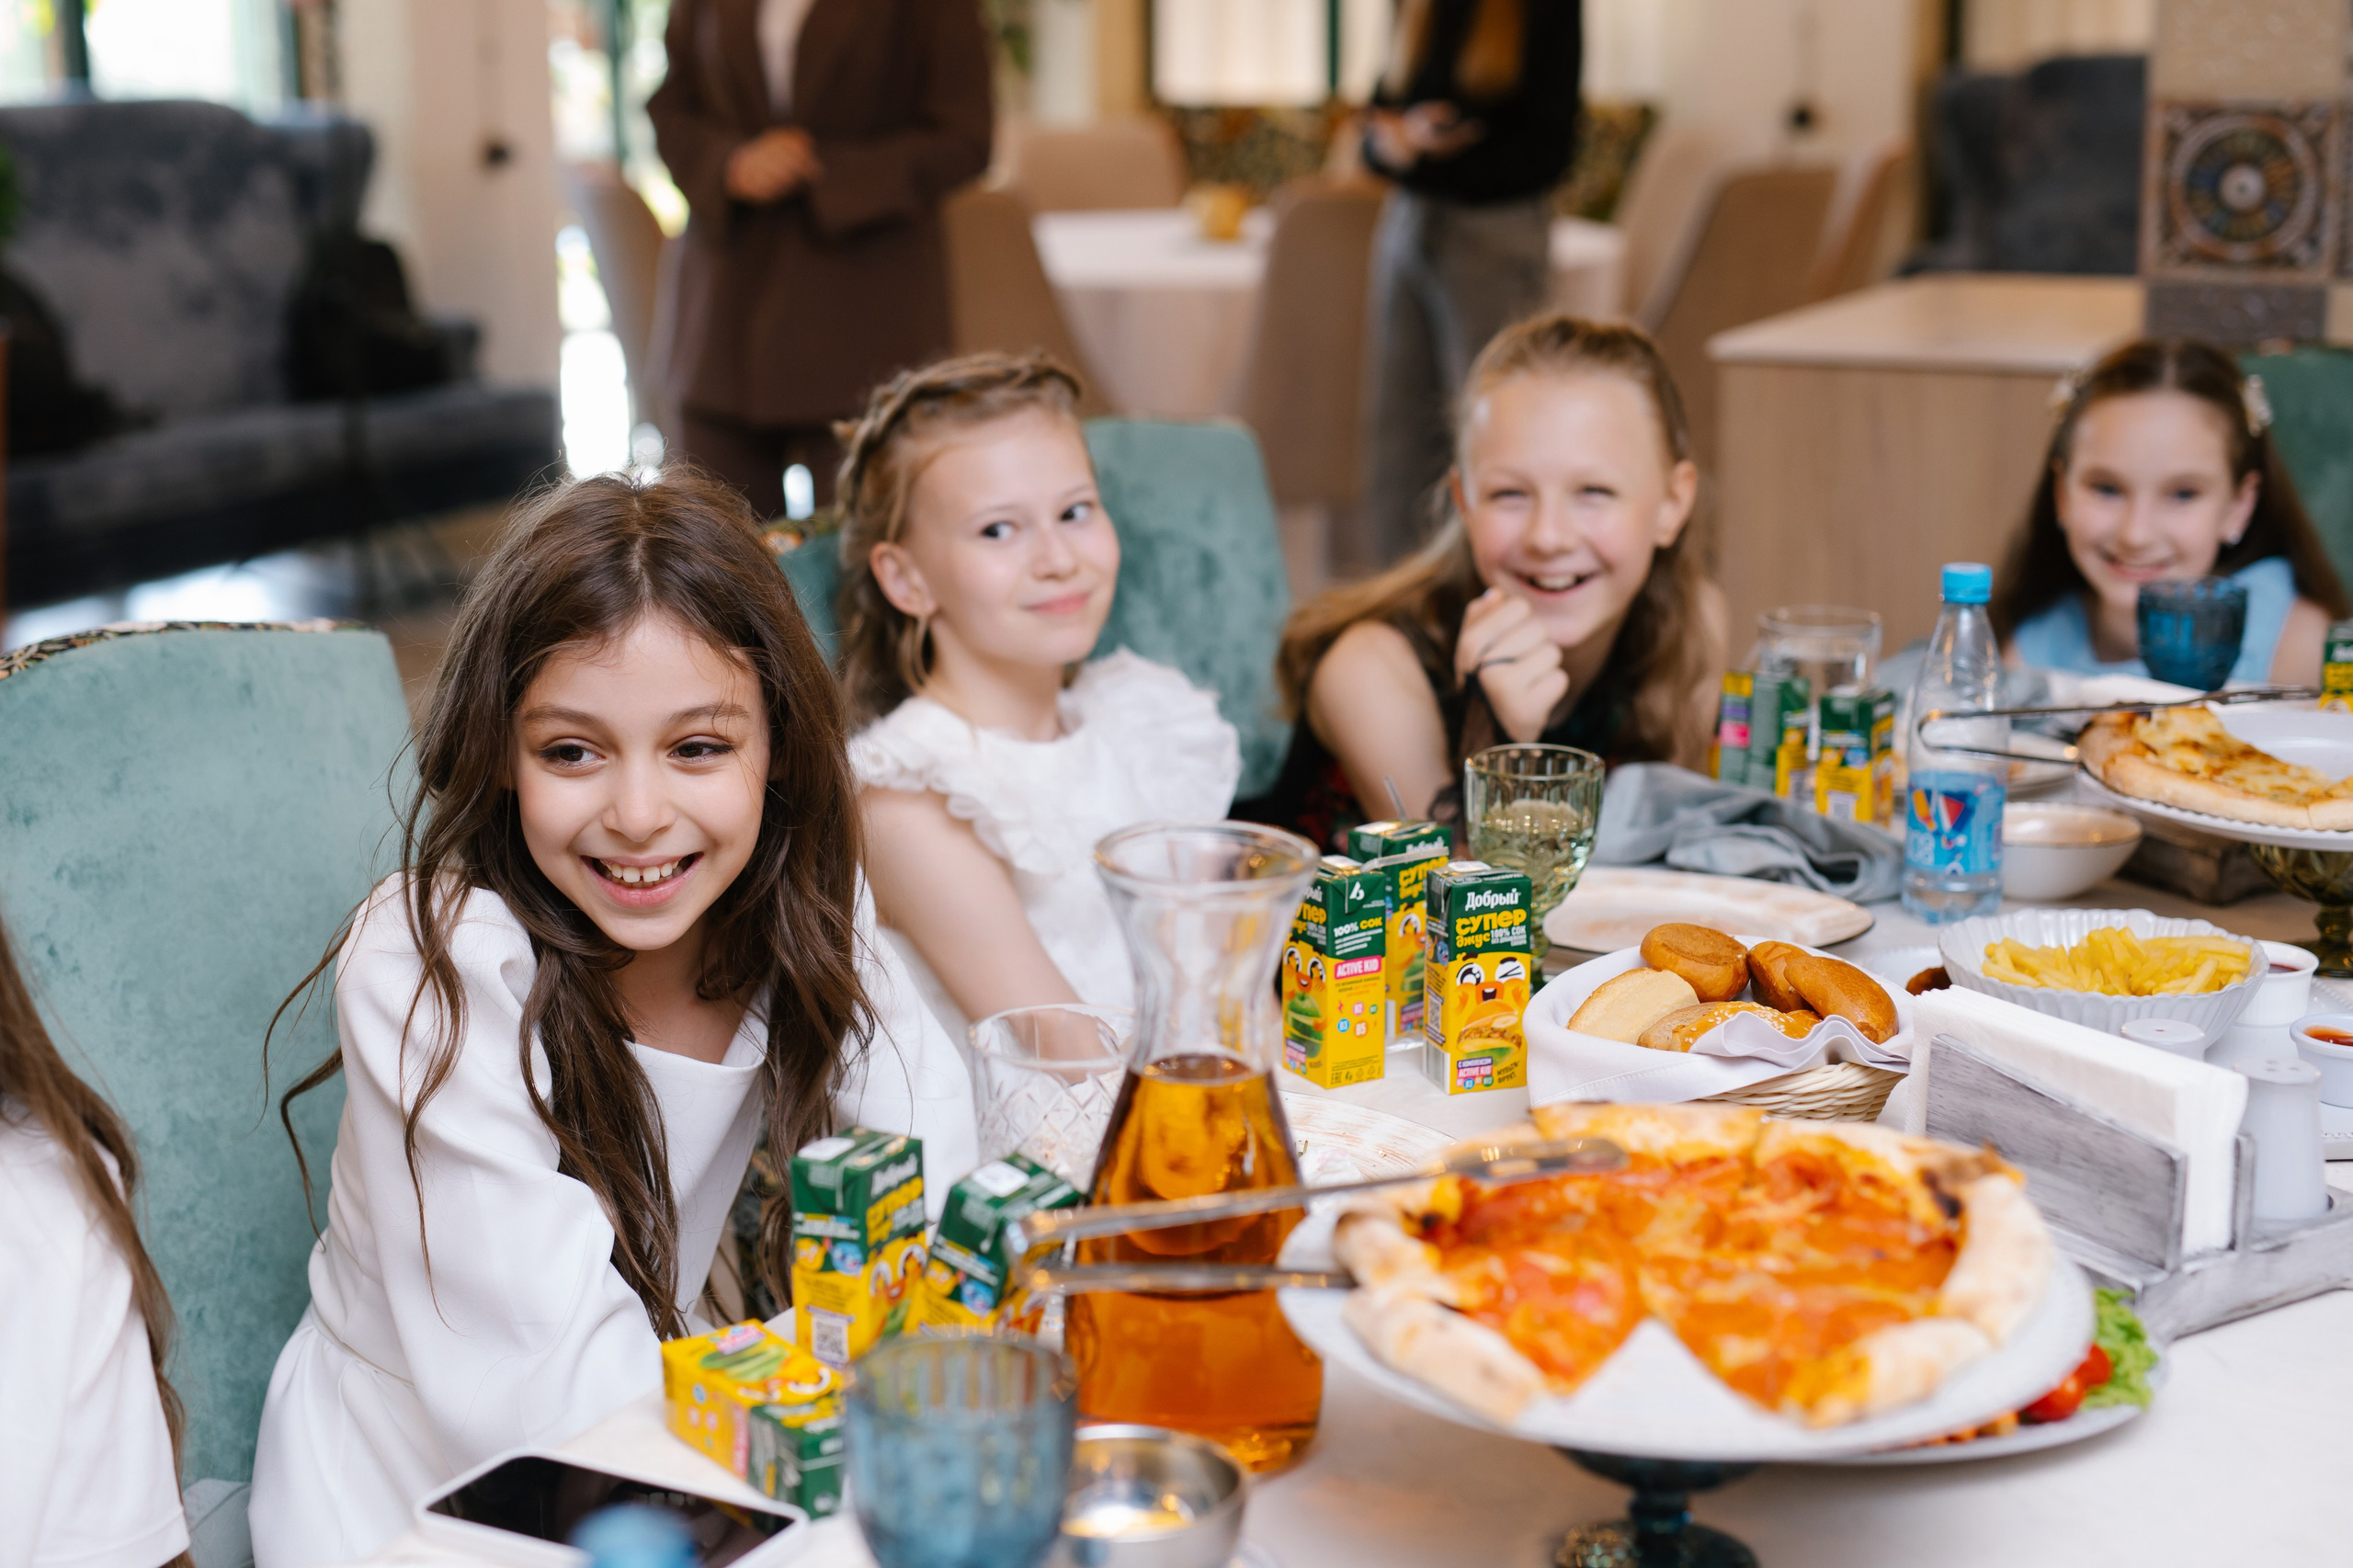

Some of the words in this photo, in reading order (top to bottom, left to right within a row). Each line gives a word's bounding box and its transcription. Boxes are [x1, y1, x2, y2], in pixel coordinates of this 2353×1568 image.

[1465, 888, 1519, 912] Добрый
[1334, 921, 1359, 937] 100%
[1490, 926, 1511, 938] 100%
[1336, 960, 1363, 978] ACTIVE
[1363, 958, 1379, 972] KID
